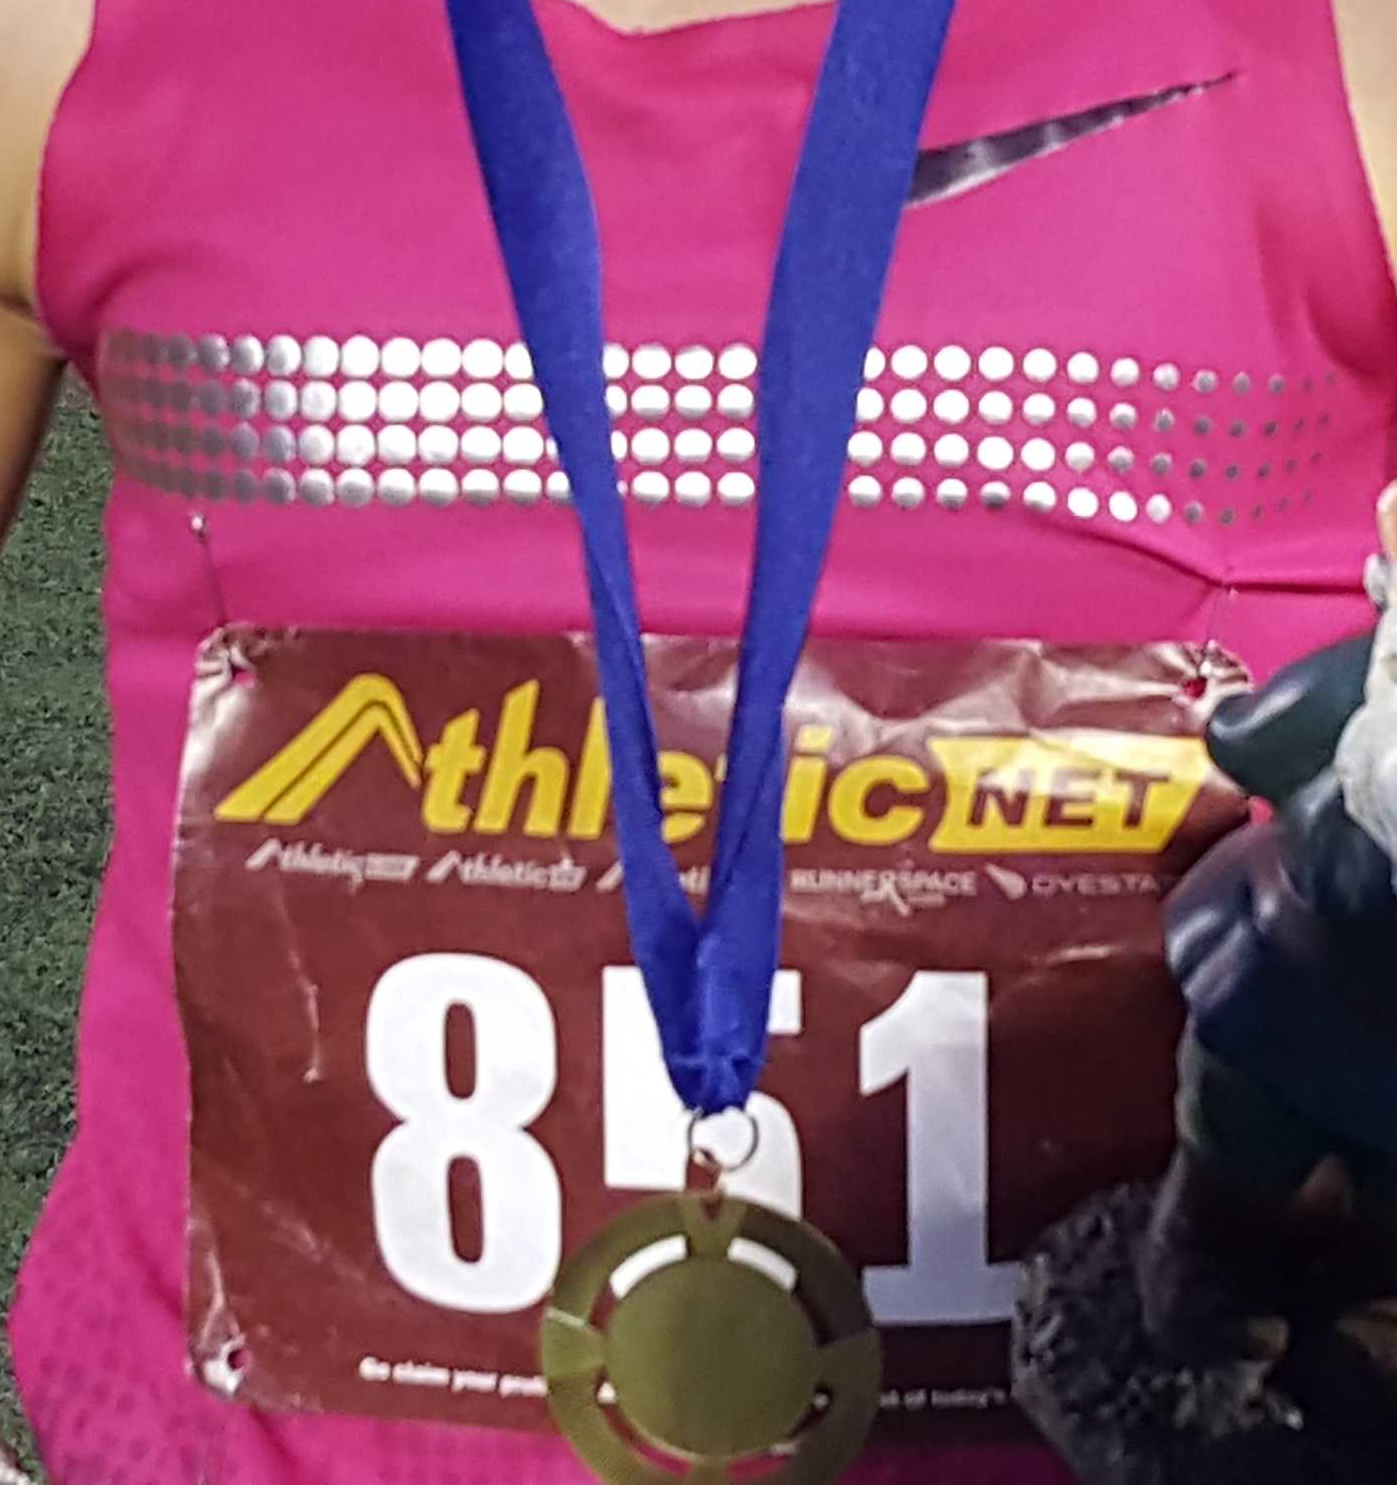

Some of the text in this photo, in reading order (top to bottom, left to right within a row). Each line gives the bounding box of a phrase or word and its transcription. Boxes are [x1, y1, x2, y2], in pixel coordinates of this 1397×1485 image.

[214, 672, 1172, 848] Athleic NET
[365, 951, 1014, 1325] 851
